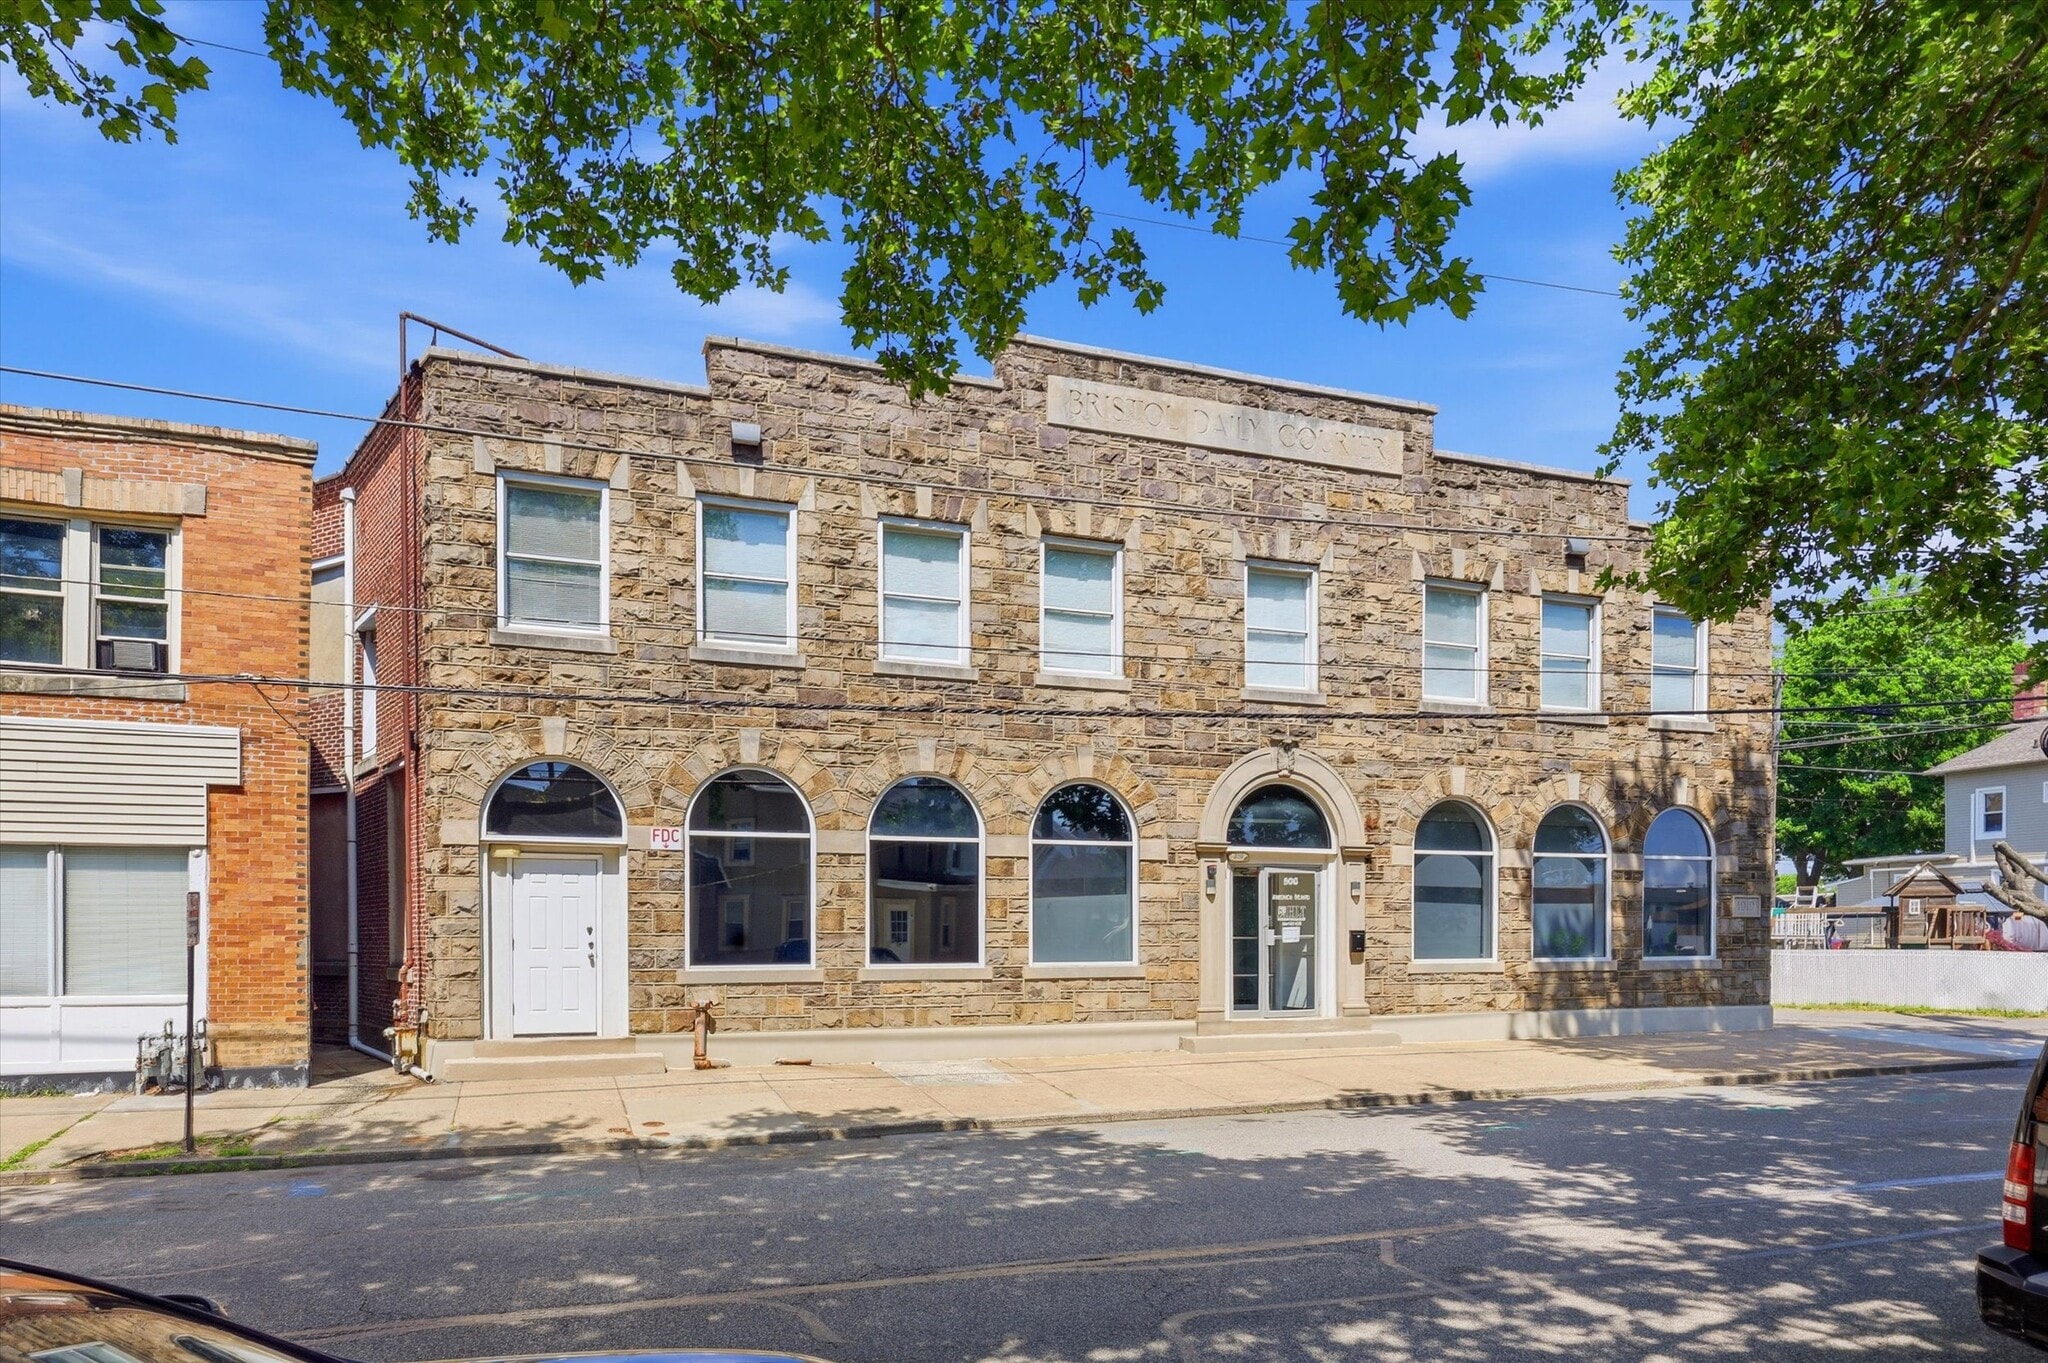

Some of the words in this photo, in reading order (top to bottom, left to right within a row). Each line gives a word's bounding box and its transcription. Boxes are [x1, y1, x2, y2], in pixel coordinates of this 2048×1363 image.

[1068, 388, 1180, 431] BRISTOL
[1192, 408, 1262, 442] DAILY
[652, 828, 680, 843] FDC
